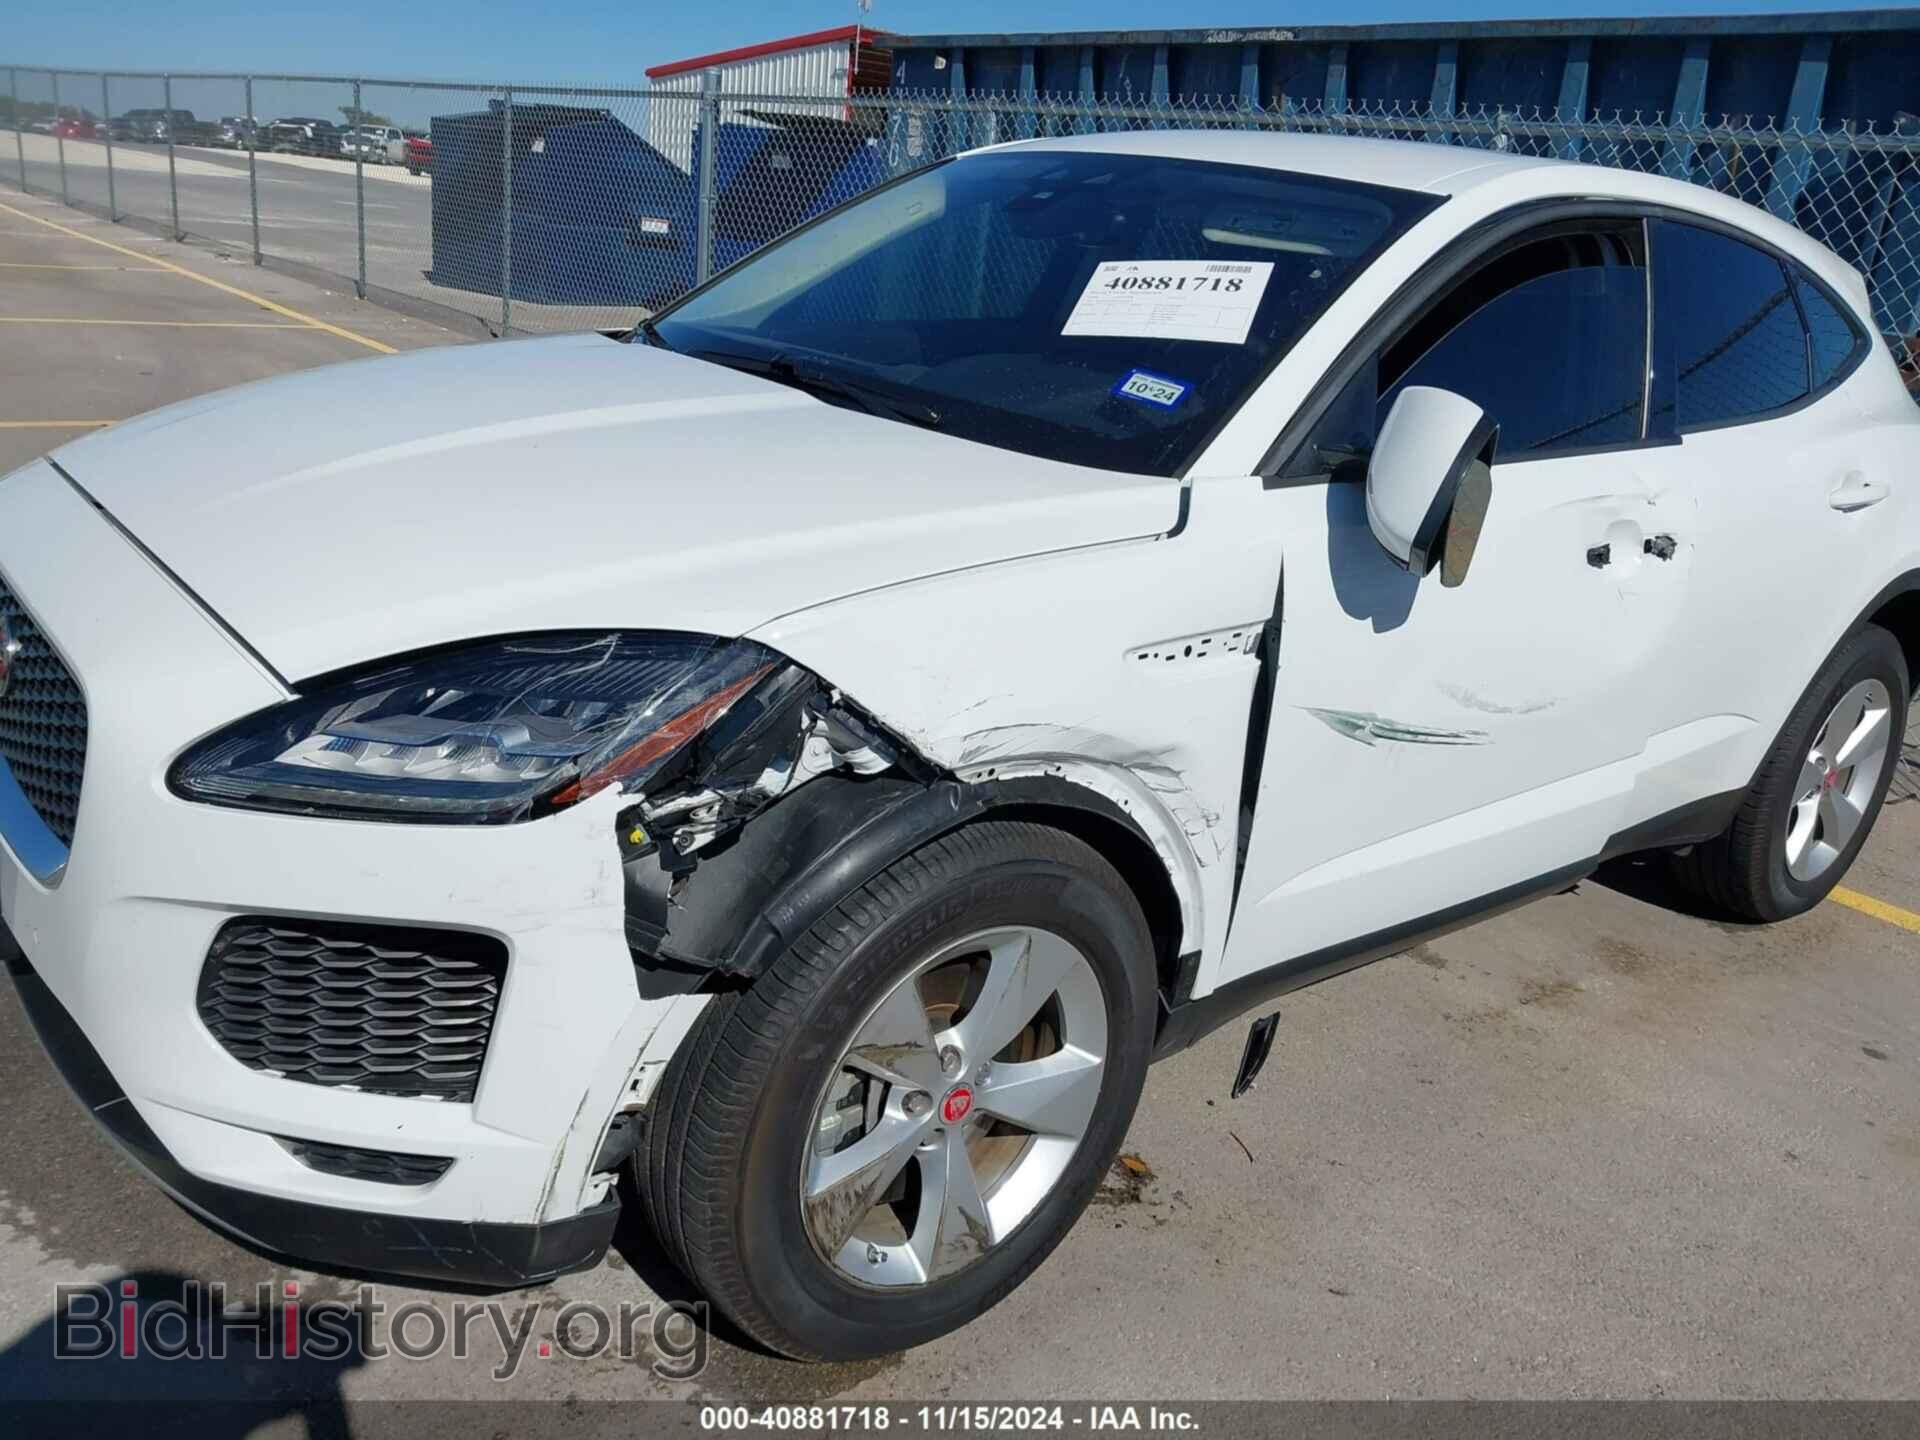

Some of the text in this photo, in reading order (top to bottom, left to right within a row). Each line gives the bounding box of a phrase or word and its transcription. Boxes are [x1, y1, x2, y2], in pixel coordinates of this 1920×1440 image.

[1105, 277, 1243, 292] 40881718
[1127, 380, 1176, 401] 10 24
